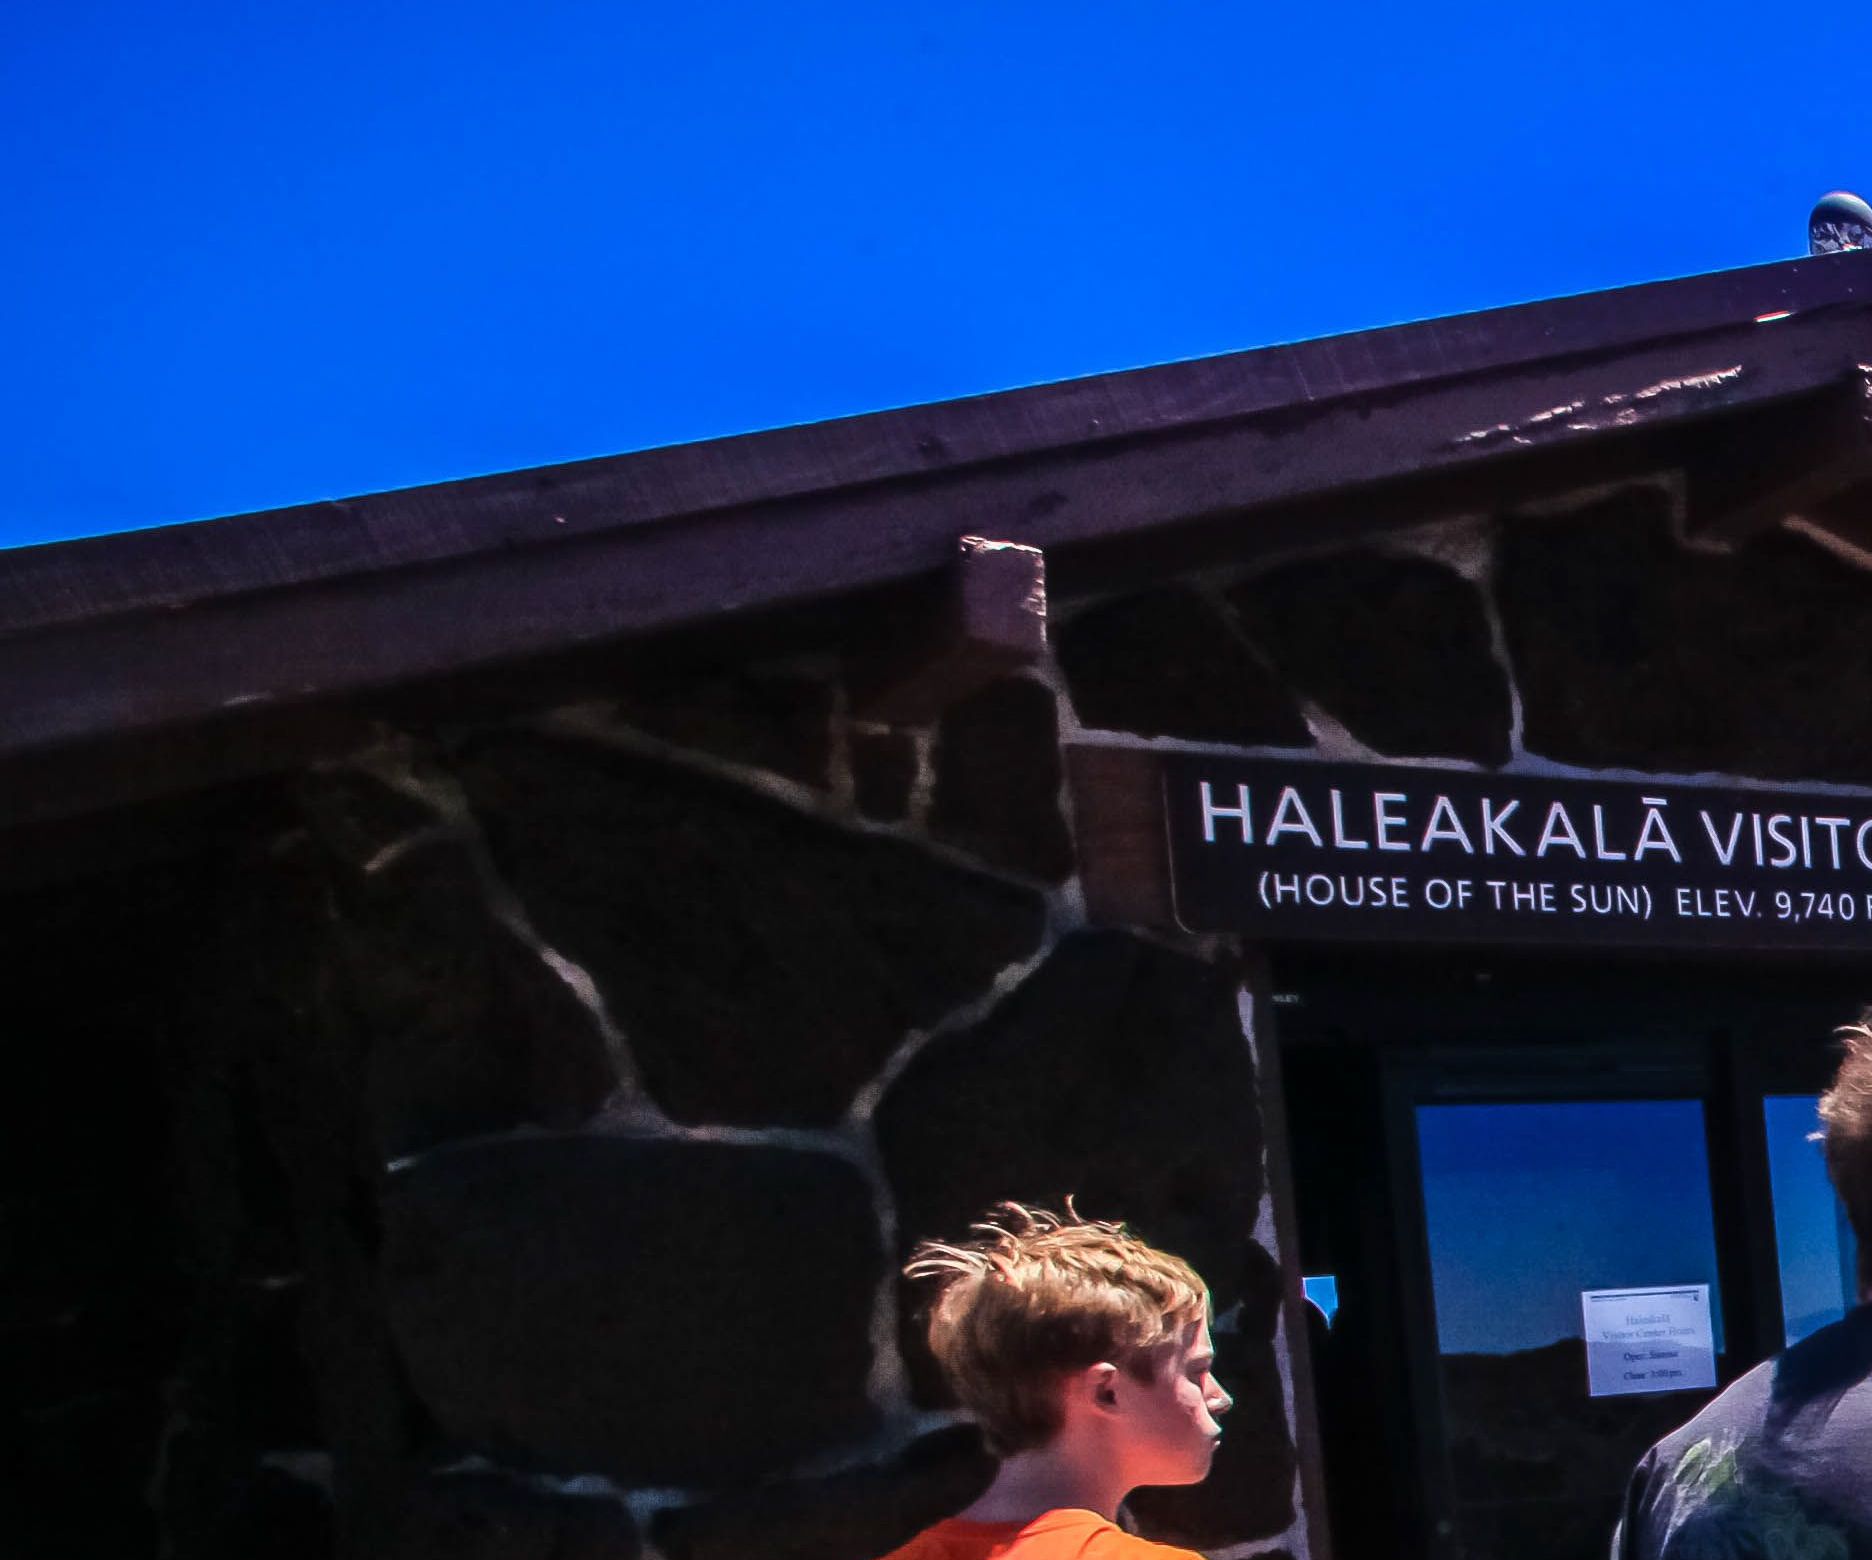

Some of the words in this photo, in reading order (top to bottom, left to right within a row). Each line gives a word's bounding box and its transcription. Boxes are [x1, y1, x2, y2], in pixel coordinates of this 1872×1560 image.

[1200, 781, 1682, 863] HALEAKALĀ
[1258, 871, 1410, 909] (HOUSE
[1424, 878, 1473, 909] OF
[1485, 880, 1557, 912] THE
[1570, 883, 1652, 920] SUN)
[1676, 887, 1762, 918] ELEV.
[1775, 890, 1855, 923] 9,740
